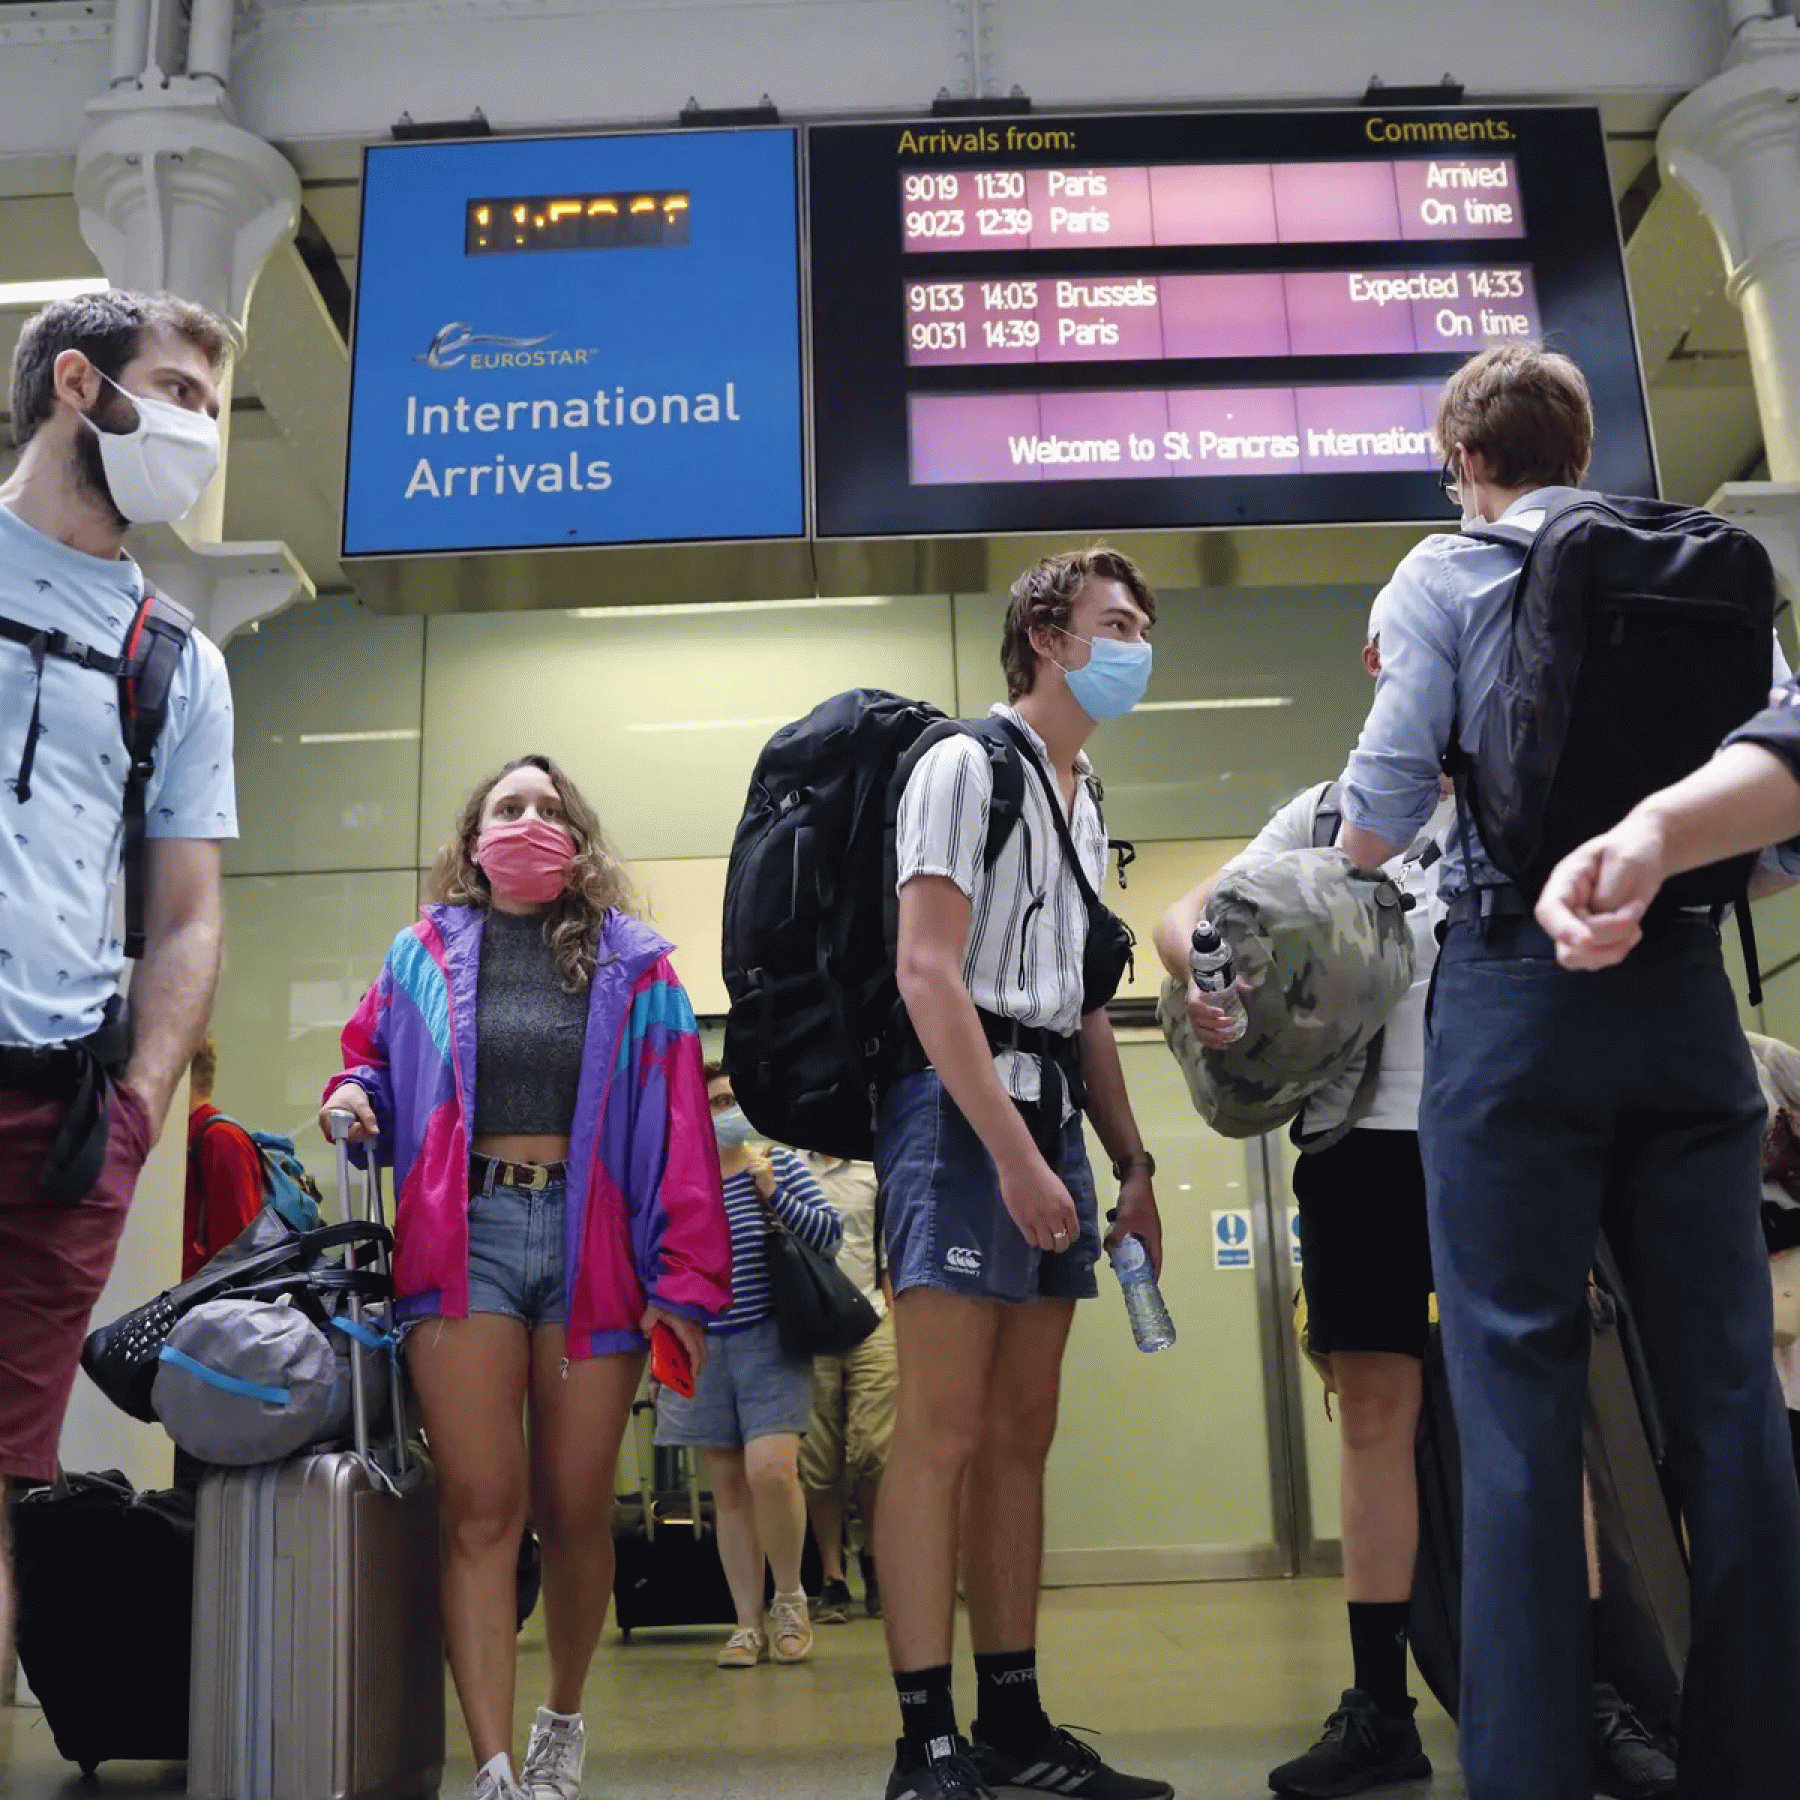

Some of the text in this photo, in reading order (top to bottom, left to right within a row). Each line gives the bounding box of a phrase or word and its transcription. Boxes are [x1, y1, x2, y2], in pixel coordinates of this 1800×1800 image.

[897, 126, 1076, 154] Arrivals from:
[1365, 117, 1516, 142] Comments.
[905, 169, 1108, 201] 9019 11:30 Paris
[1427, 161, 1508, 188] Arrived
[905, 206, 1110, 237] 9023 12:39 Paris
[1421, 197, 1513, 225] On time
[910, 278, 1158, 312] 9133 14:03 Brussels
[1349, 270, 1524, 307] Expected 14:33
[911, 317, 1120, 350] 9031 14:39 Paris
[1436, 308, 1530, 337] On time
[470, 348, 589, 370] EUROSTAR
[405, 381, 741, 436] International
[1008, 426, 1438, 465] Welcome to St Pancras Internation
[404, 451, 613, 499] Arrivals
